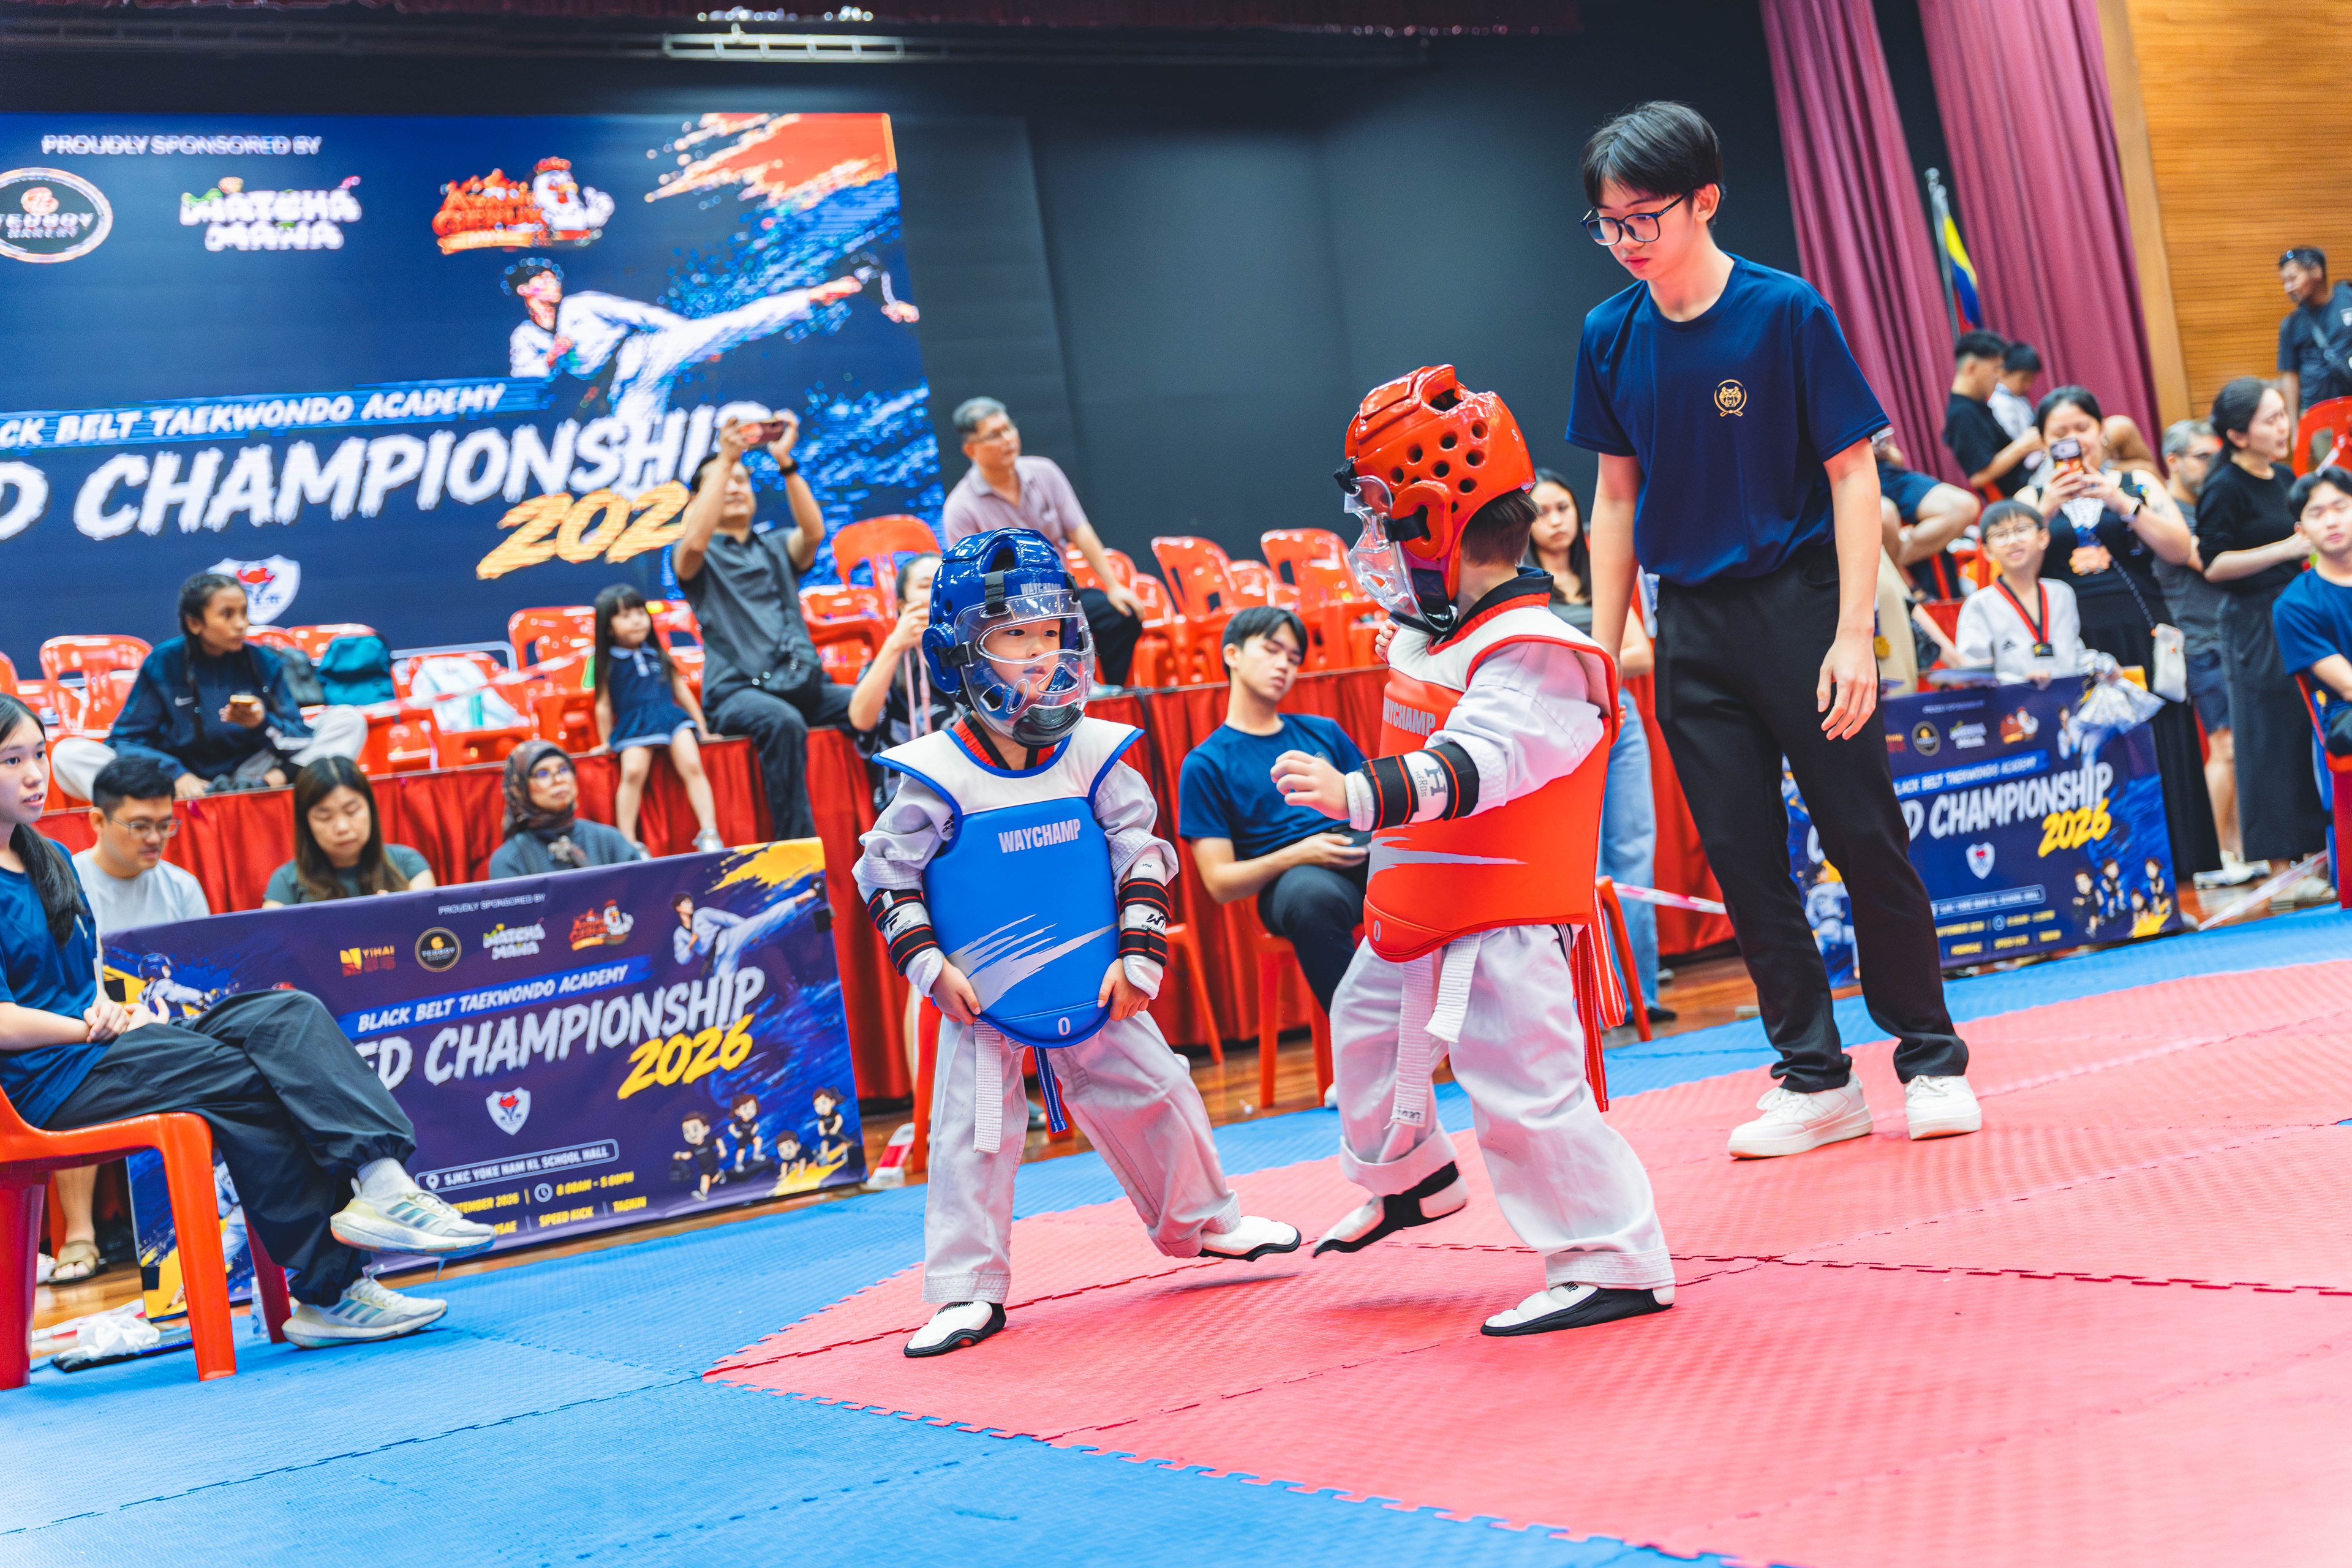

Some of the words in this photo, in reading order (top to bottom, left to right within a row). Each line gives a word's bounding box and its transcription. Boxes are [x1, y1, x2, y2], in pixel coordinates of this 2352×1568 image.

[41, 135, 149, 155] PROUDLY
[150, 135, 291, 155] SPONSORED
[293, 135, 323, 154] BY
[179, 189, 363, 226] MATCHA
[54, 410, 143, 444] BELT
[148, 395, 352, 437] TAEKWONDO
[361, 382, 507, 419] ACADEMY
[1511, 429, 1519, 442] S
[476, 479, 693, 579] 202
[1929, 761, 2114, 840] CHAMPIONSHIP
[998, 818, 1081, 853] WAYCHAMP
[2037, 797, 2112, 858] 2026
[438, 901, 480, 916] PROUDLY
[480, 894, 533, 910] SPONSORED
[533, 892, 546, 903] BY
[357, 1006, 412, 1033] BLACK
[415, 998, 454, 1022] BELT
[459, 978, 556, 1014] TAEKWONDO
[559, 964, 628, 993] ACADEMY
[424, 966, 766, 1086] CHAMPIONSHIP
[617, 1014, 755, 1100] 2026
[472, 1164, 500, 1181] YOKE
[500, 1159, 526, 1175] NAM
[541, 1150, 581, 1169] SCHOOL
[538, 1210, 570, 1227] SPEED
